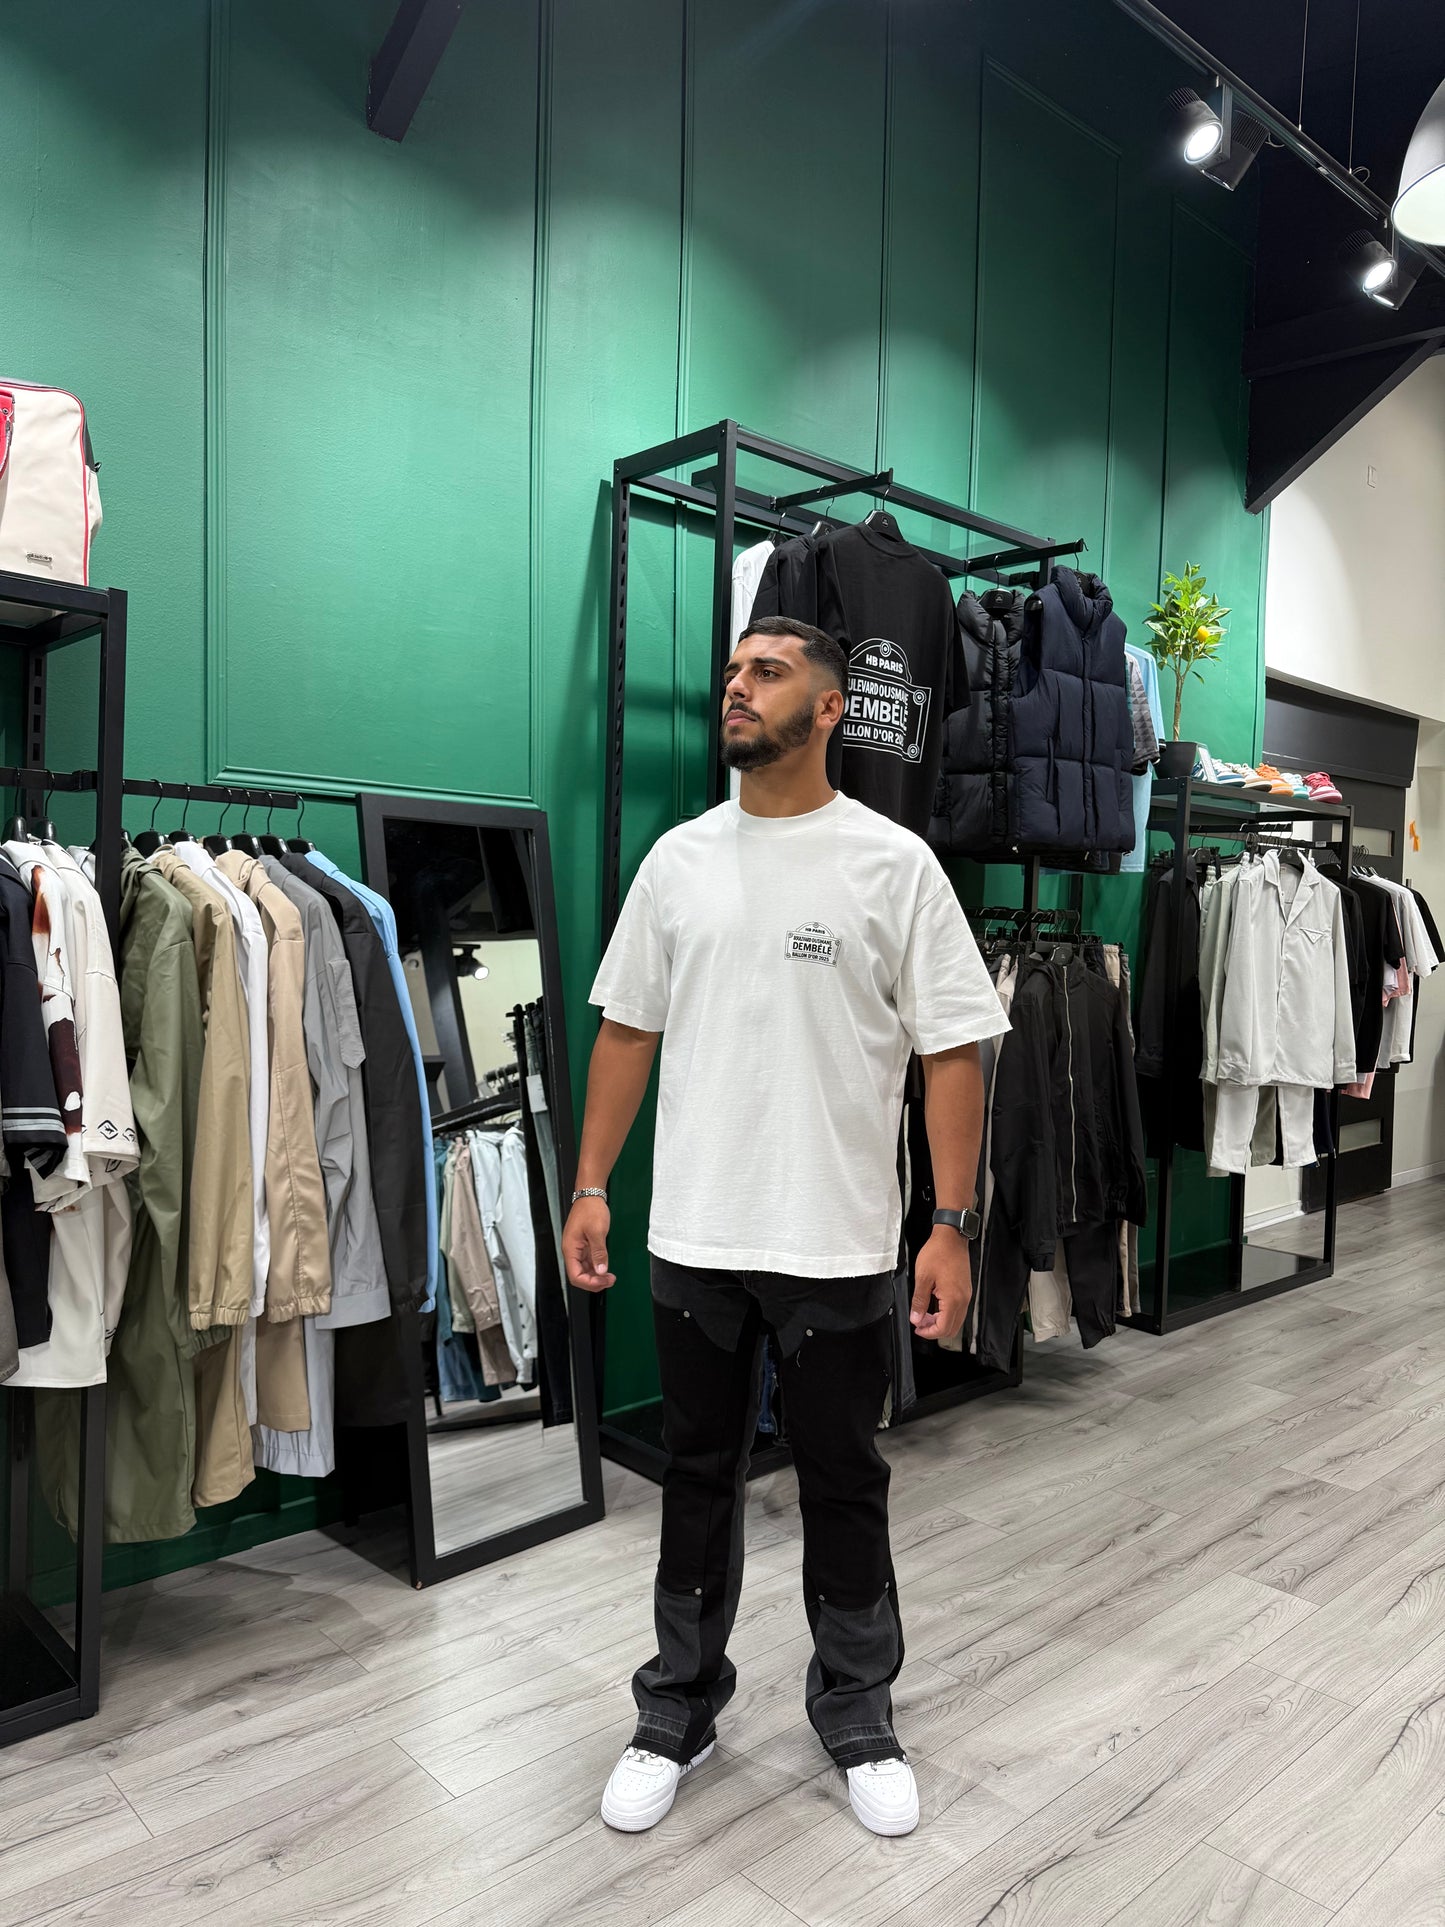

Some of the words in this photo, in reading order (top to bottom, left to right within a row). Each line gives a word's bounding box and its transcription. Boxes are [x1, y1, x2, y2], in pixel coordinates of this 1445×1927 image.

[866, 654, 878, 666] HB
[879, 658, 903, 673] PARIS
[873, 727, 894, 743] D'OR
[793, 942, 832, 955] DEMBÉLÉ
